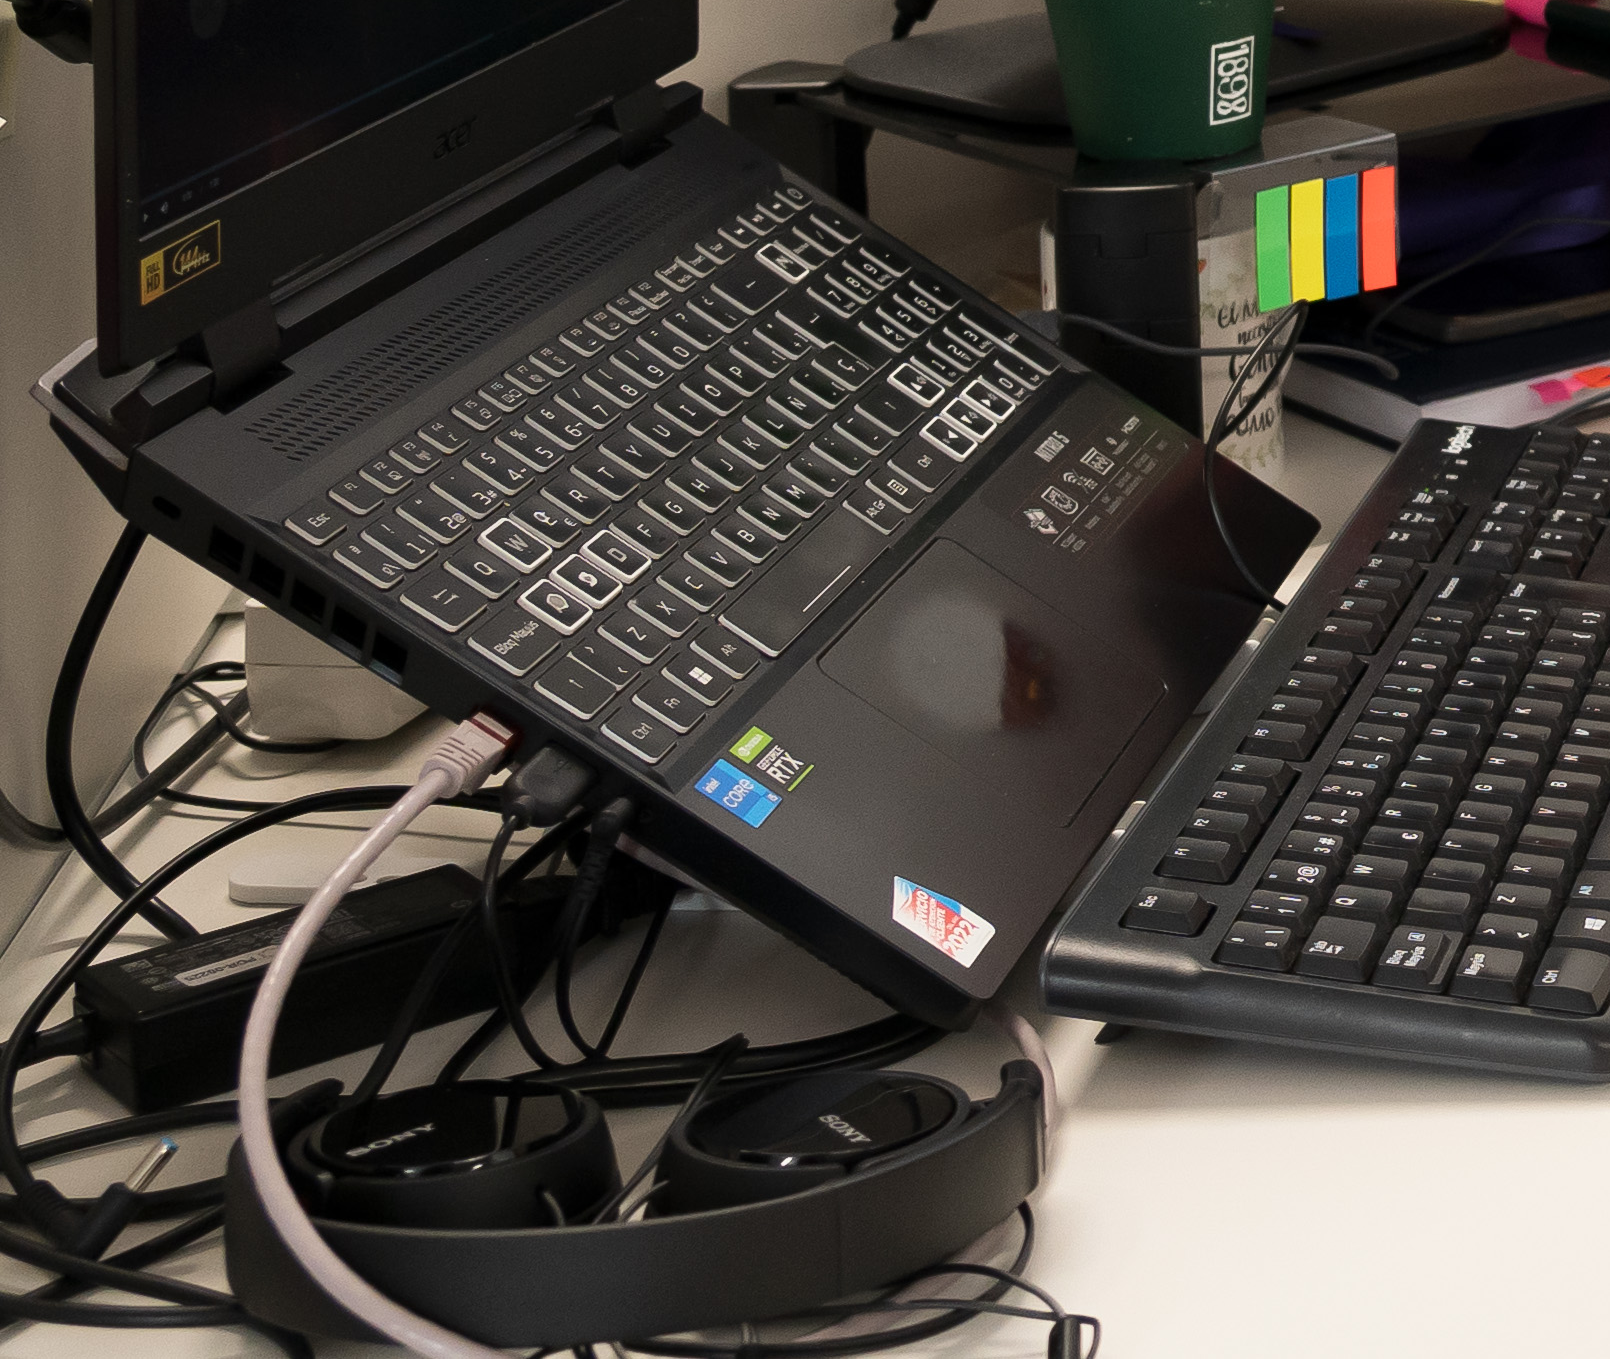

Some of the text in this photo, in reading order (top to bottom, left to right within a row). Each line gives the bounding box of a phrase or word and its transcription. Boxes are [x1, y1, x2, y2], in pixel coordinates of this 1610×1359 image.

[1216, 42, 1250, 116] 1898
[863, 264, 877, 274] 9
[146, 273, 160, 294] HD
[897, 310, 911, 322] 5
[964, 331, 978, 341] 3
[673, 346, 689, 357] 0
[647, 365, 664, 377] 9
[729, 367, 742, 378] P
[620, 385, 638, 396] 8
[705, 385, 721, 396] O
[787, 396, 806, 410] Ñ
[592, 405, 608, 416] 7
[680, 405, 696, 416] I
[565, 425, 582, 436] 6
[767, 420, 784, 429] L
[653, 425, 670, 437] U
[742, 437, 760, 450] K
[535, 447, 553, 458] 5
[626, 445, 642, 456] Y
[721, 459, 733, 471] J
[508, 468, 526, 480] 4
[598, 467, 614, 478] T
[691, 479, 710, 492] H
[569, 490, 588, 502] R
[786, 485, 805, 499] M
[471, 492, 489, 505] 3
[665, 501, 683, 513] G
[762, 507, 780, 520] N
[307, 513, 330, 527] Esc
[440, 514, 458, 529] 2
[637, 524, 651, 537] F
[737, 530, 755, 542] B
[407, 543, 425, 554] 1
[607, 548, 627, 562] D
[711, 552, 727, 564] V
[474, 562, 496, 575] Q
[685, 576, 703, 589] C
[656, 601, 676, 615] X
[627, 627, 646, 640] Z
[631, 722, 654, 740] Ctrl
[766, 752, 804, 784] RTX
[1353, 865, 1373, 873] W
[1139, 896, 1158, 907] Esc
[1542, 970, 1559, 983] Ctrl
[818, 1114, 871, 1144] SONY
[345, 1122, 436, 1158] SONY
